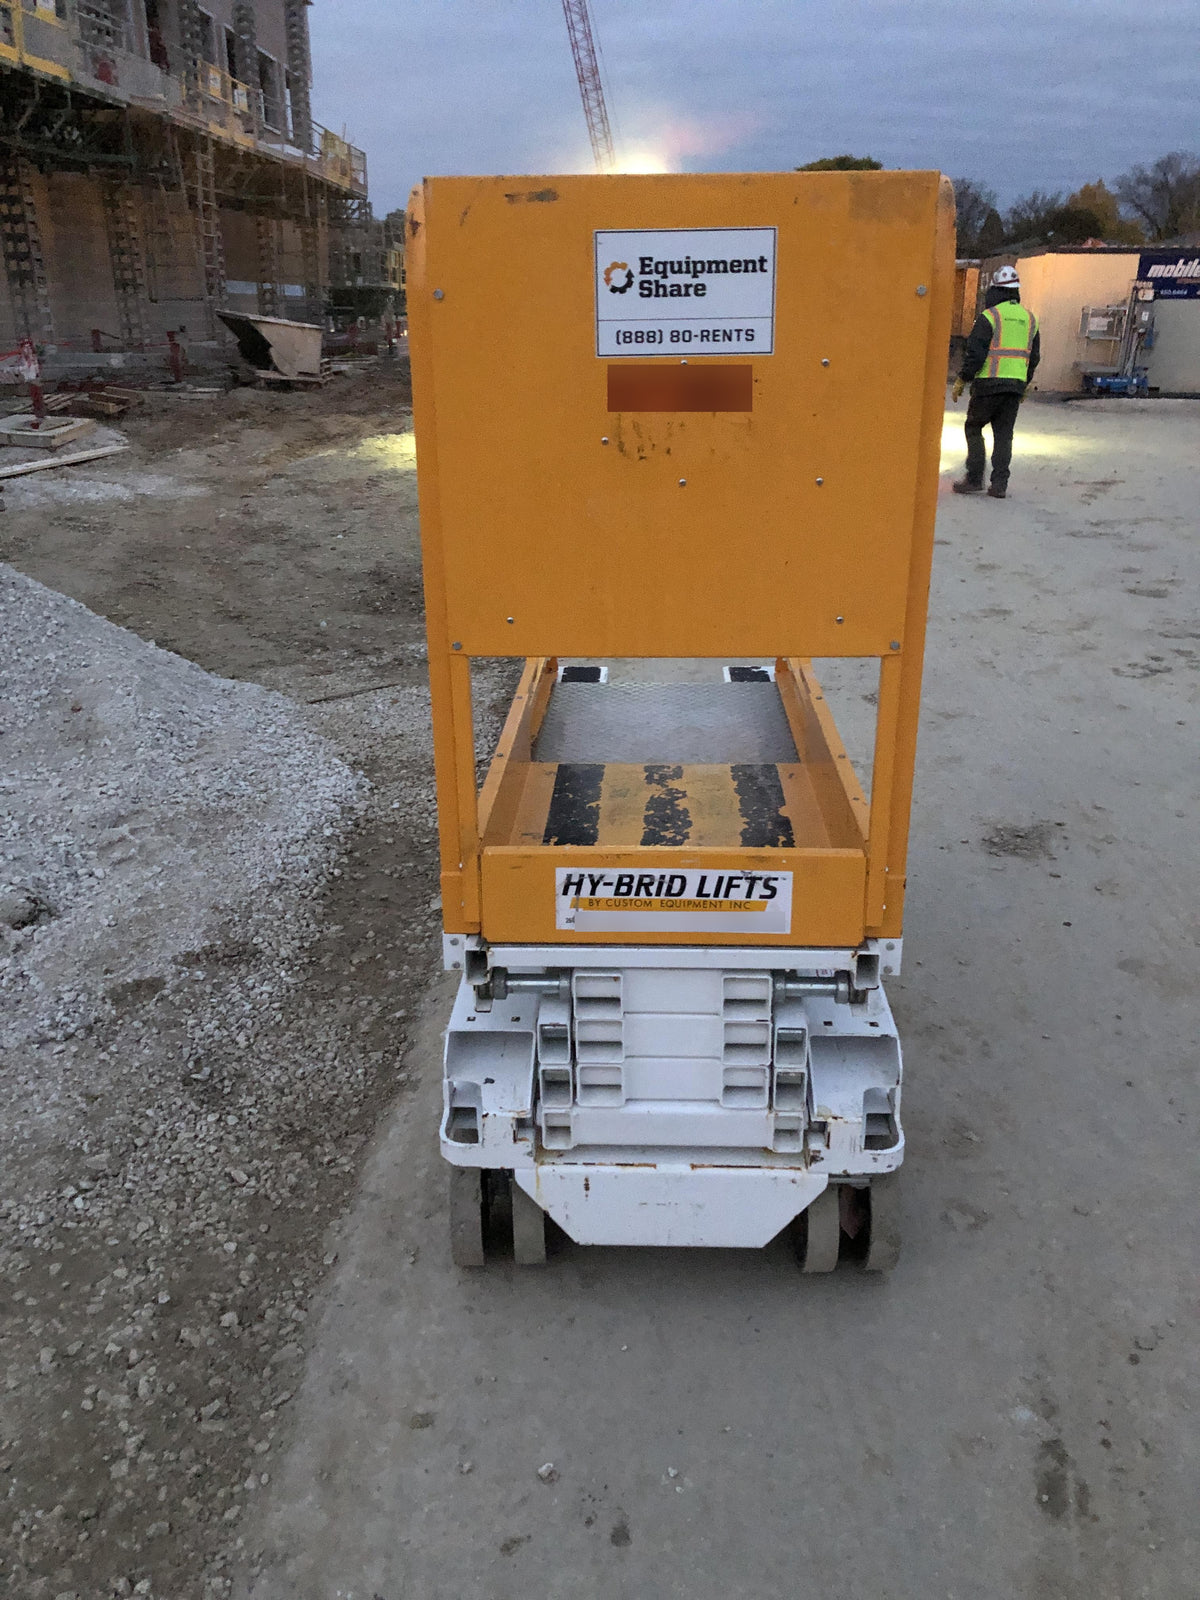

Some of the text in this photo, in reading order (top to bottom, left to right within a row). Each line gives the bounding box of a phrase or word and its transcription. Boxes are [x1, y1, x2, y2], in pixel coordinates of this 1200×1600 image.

[639, 256, 768, 278] Equipment
[639, 280, 707, 298] Share
[616, 328, 755, 346] (888) 80-RENTS
[561, 873, 779, 900] HY-BRID LIFTS
[588, 898, 751, 910] BY CUSTOM EQUIPMENT INC
